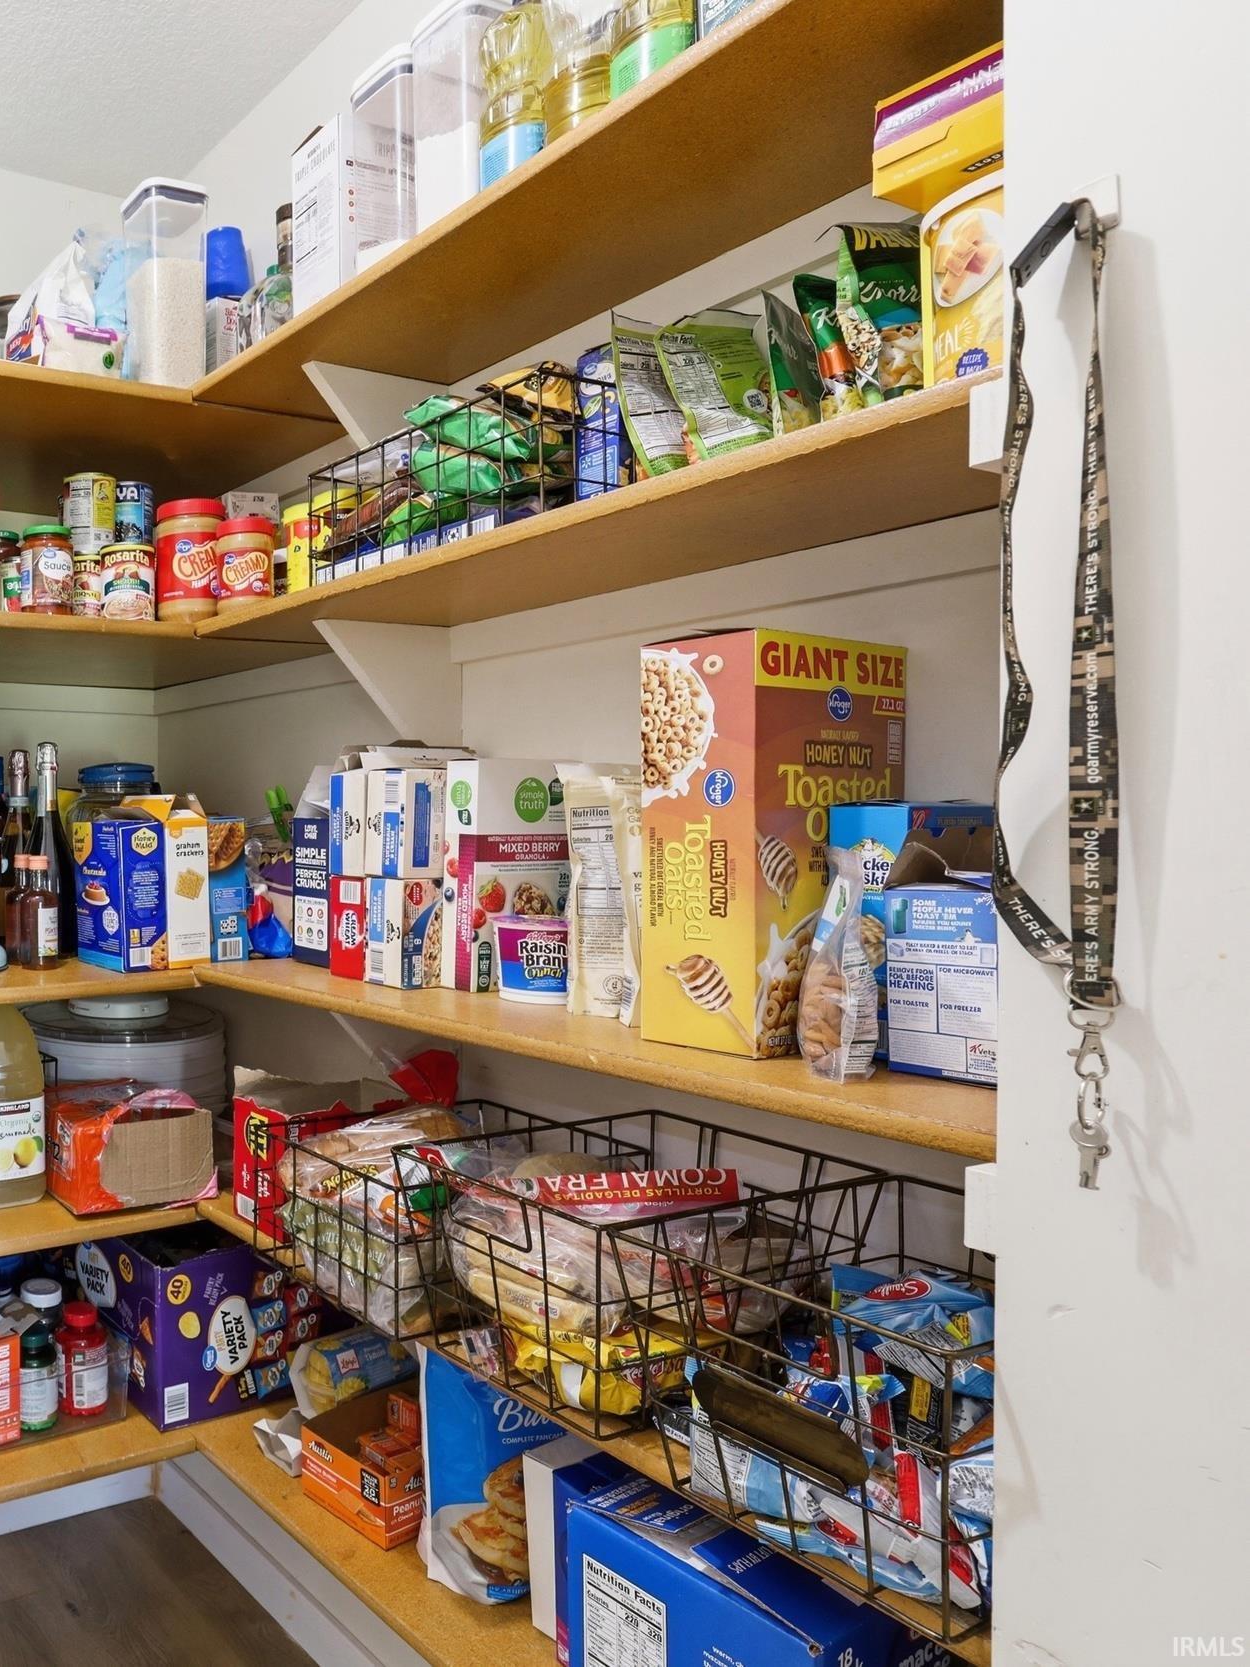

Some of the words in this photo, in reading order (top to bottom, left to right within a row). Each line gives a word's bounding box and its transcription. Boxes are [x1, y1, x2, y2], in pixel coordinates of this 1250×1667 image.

[859, 281, 922, 303] Knorr
[1087, 444, 1097, 483] THEN
[116, 487, 139, 500] YA
[104, 549, 150, 567] Rosarita
[43, 560, 71, 572] Sauce
[226, 554, 268, 582] CREAMY
[1084, 552, 1098, 614] THERE'S
[760, 640, 849, 682] GIANT
[856, 652, 904, 689] SIZE
[829, 693, 852, 714] Kroger
[1087, 651, 1103, 784] goarmyreserve.com
[806, 743, 845, 765] HONEY
[849, 747, 872, 767] NUT
[709, 771, 729, 805] Kroger
[778, 763, 892, 808] Toasted
[519, 790, 545, 803] simple
[518, 799, 546, 811] truth
[572, 808, 610, 818] Nutrition
[175, 842, 201, 852] graham
[175, 849, 205, 857] crackers
[295, 847, 327, 860] SIMPLE
[499, 843, 530, 853] MIXED
[532, 843, 561, 853] BERRY
[515, 853, 547, 861] GRANOLA
[712, 842, 725, 885] HONEY
[1086, 826, 1101, 890] STRONG.
[295, 868, 327, 880] PERFECT
[664, 841, 685, 911] Oats
[684, 814, 712, 941] Toasted
[295, 878, 327, 890] CRUNCH
[712, 888, 726, 916] NUT
[912, 899, 937, 907] SOME
[912, 906, 943, 914] PEOPLE
[1086, 894, 1099, 935] ARMY
[1008, 896, 1055, 958] THERE'S
[519, 941, 568, 958] Raisin
[524, 954, 564, 968] Bran
[524, 966, 565, 980] Crunch
[889, 966, 913, 975] REMOVE
[915, 968, 934, 976] FROM
[889, 973, 905, 981] FOIL
[906, 974, 934, 982] BEFORE
[953, 968, 994, 977] MICROWAVE
[888, 980, 934, 991] HEATING
[902, 1000, 929, 1008] TOASTER
[954, 1005, 981, 1013] FREEZER
[0, 1104, 31, 1112] KIRKLAND
[0, 1116, 29, 1128] Organic
[553, 1188, 642, 1201] DELGADITAS
[645, 1186, 722, 1198] TORTILLAS
[79, 1260, 110, 1282] VARIETY
[87, 1279, 106, 1297] PACK
[170, 1279, 184, 1300] 40
[220, 1310, 240, 1365] VARIETY
[233, 1315, 248, 1350] PACK
[501, 1435, 535, 1445] COMPLETE
[308, 1440, 334, 1463] Austin
[586, 1560, 631, 1596] Nutrition
[634, 1590, 663, 1616] Facts
